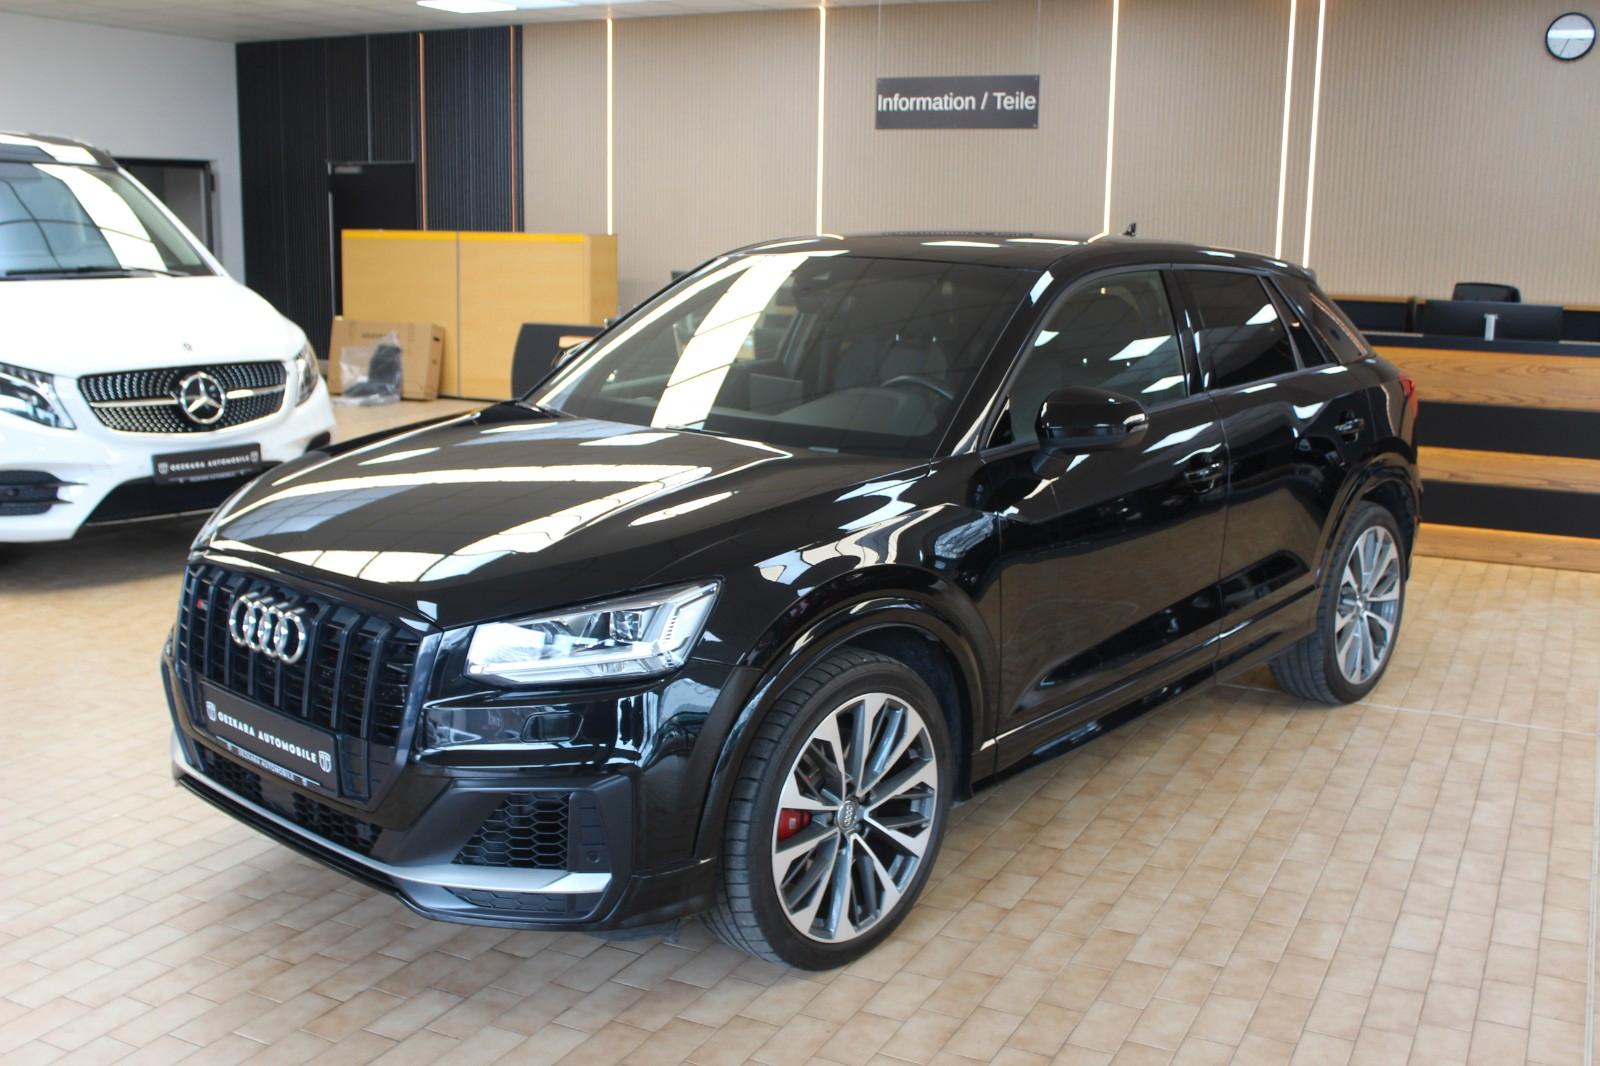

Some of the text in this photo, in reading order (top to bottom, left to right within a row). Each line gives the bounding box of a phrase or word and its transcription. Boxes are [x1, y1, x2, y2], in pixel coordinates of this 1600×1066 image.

[877, 91, 1036, 111] Information / Teile
[207, 455, 249, 467] AUTOMOBILE
[258, 730, 317, 763] AUTOMOBILE
